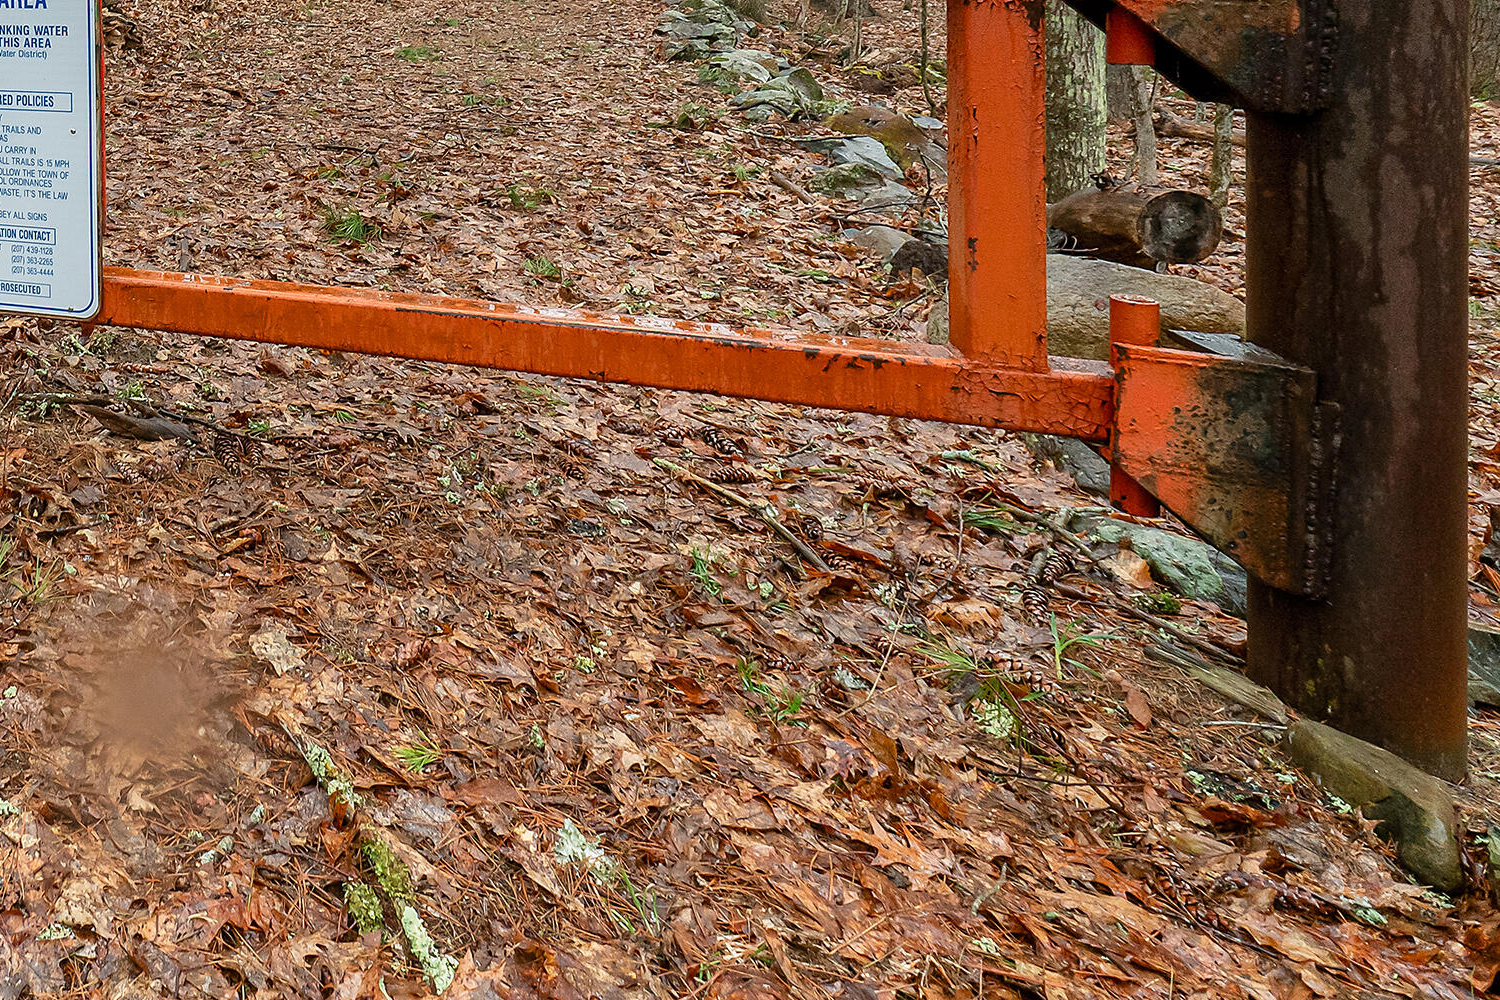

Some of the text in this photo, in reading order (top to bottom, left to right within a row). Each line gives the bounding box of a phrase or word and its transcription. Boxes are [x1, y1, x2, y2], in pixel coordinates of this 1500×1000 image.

[35, 25, 68, 36] WATER
[24, 38, 51, 48] AREA
[19, 49, 47, 58] District)
[17, 95, 54, 107] POLICIES
[2, 126, 25, 134] TRAILS
[5, 146, 27, 154] CARRY
[39, 190, 51, 198] THE
[53, 191, 68, 200] LAW
[13, 212, 25, 220] ALL
[28, 213, 47, 221] SIGNS
[19, 229, 50, 241] CONTACT
[11, 244, 24, 255] (207)
[11, 265, 25, 276] (207)
